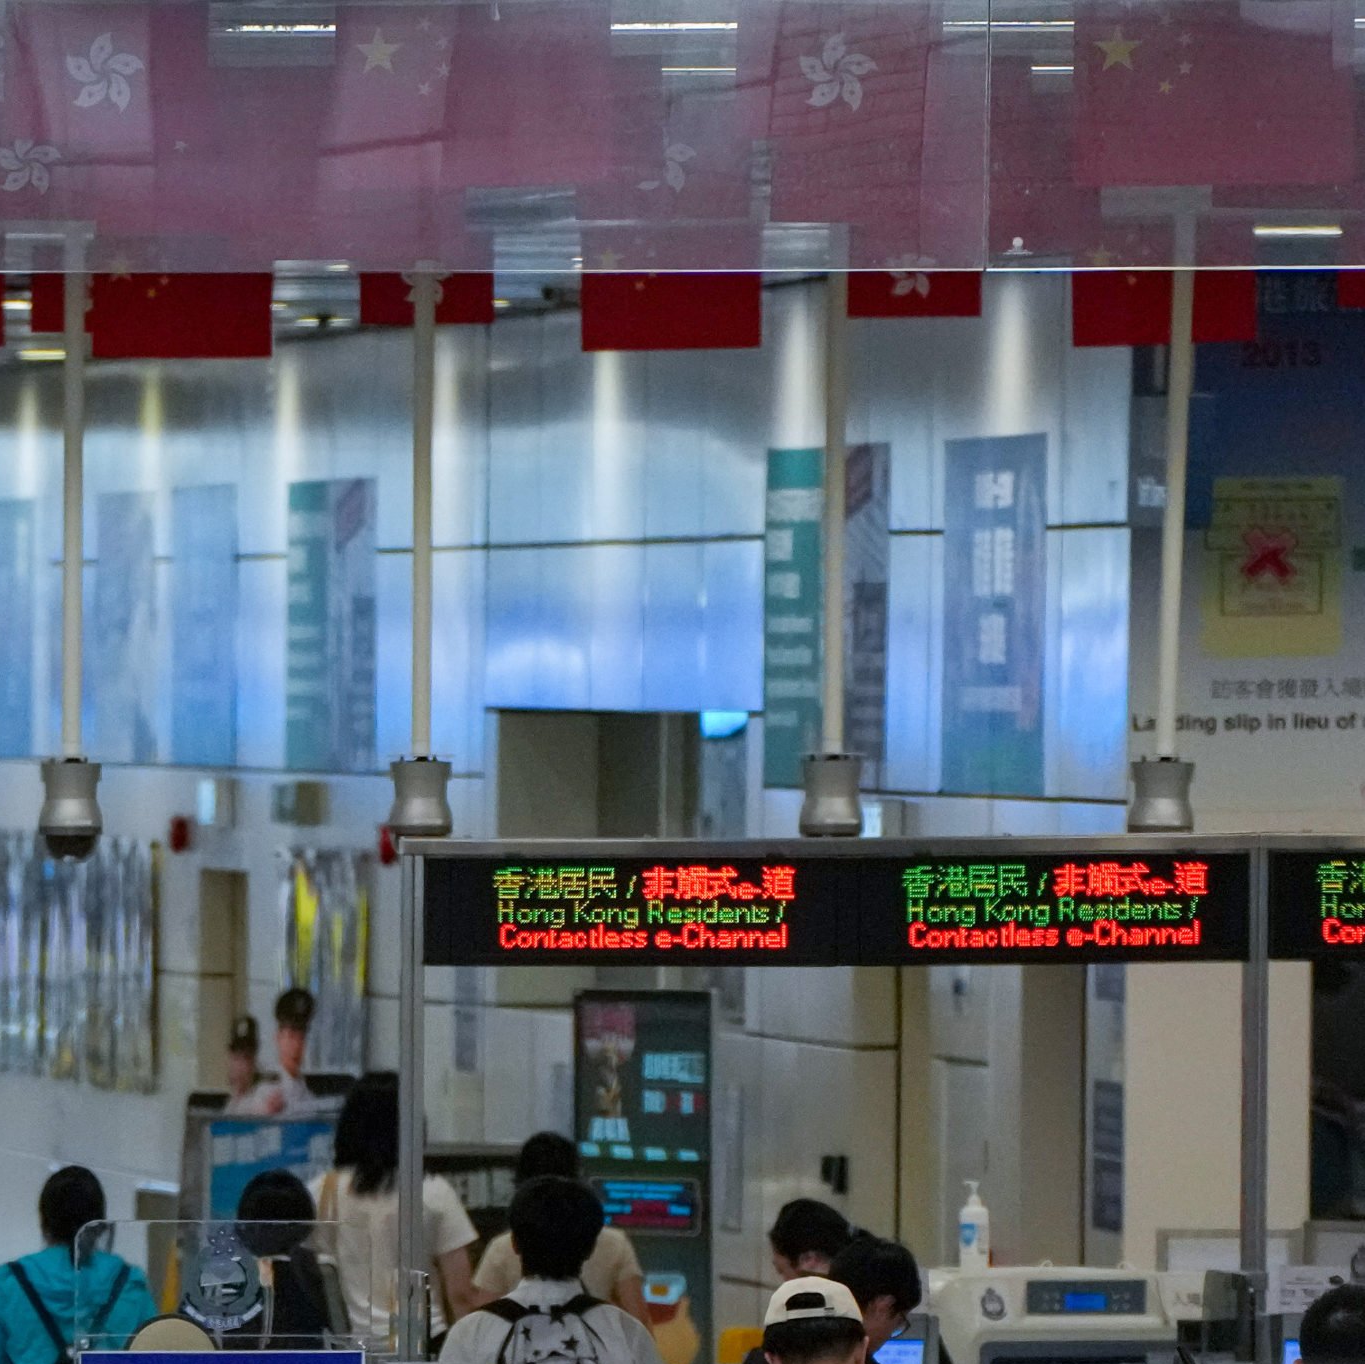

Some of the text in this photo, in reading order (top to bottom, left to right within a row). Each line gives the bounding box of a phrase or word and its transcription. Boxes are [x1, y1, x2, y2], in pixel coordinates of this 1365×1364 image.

[1132, 711, 1358, 736] Lading slip in lieu of
[493, 865, 619, 900] 香港居民
[901, 864, 1029, 898] 香港居民
[496, 900, 566, 927] Hong
[573, 900, 639, 929] Kong
[647, 899, 771, 924] Residents
[905, 900, 976, 928] Hong
[984, 899, 1050, 927] Kong
[1058, 897, 1182, 922] Residents
[498, 922, 788, 950] Contactless e-Channel
[907, 919, 1202, 950] Contactless e-Channel
